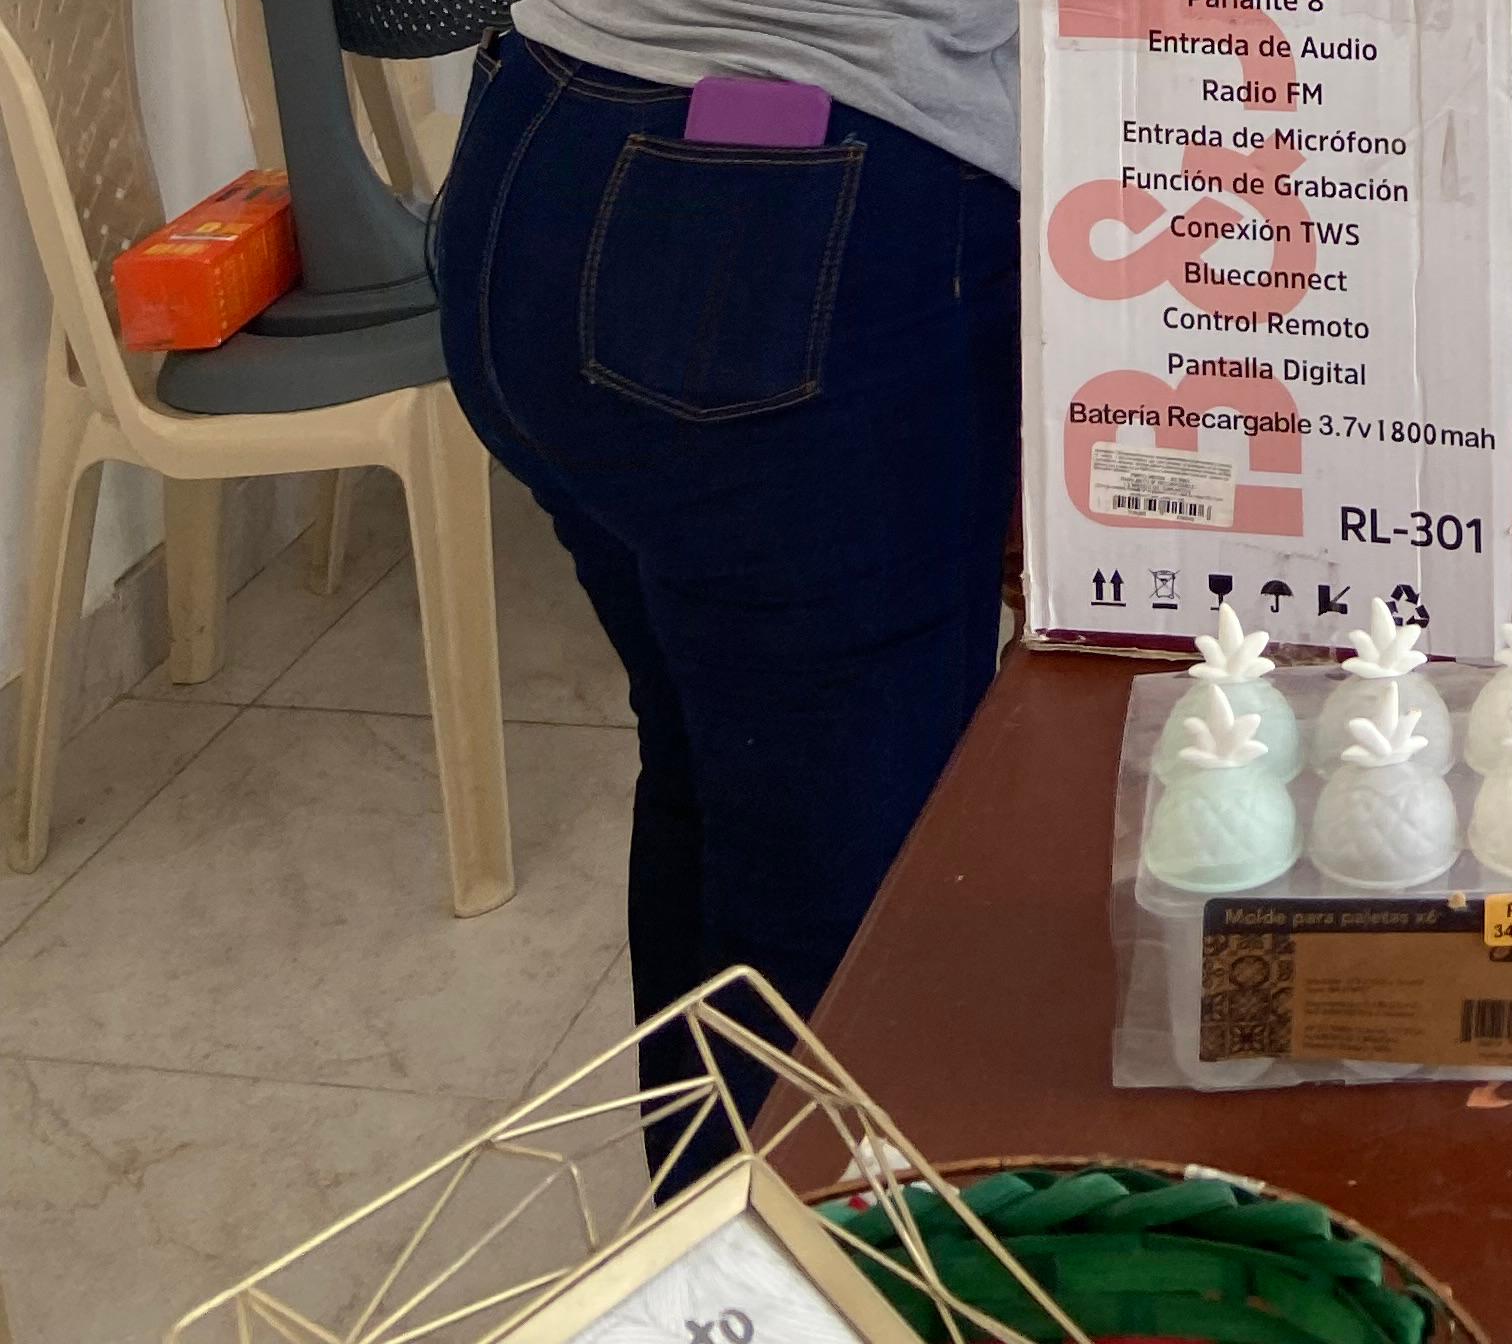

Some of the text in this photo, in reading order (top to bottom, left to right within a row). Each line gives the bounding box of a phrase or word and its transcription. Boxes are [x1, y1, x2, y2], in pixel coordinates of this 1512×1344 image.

[1149, 29, 1378, 61] Entrada de Audio
[1202, 79, 1323, 106] Radio FM
[1123, 120, 1407, 156] Entrada de Micrófono
[1122, 166, 1408, 202] Función de Grabación
[1170, 215, 1360, 246] Conexión TWS
[1184, 261, 1348, 292] Blueconnect
[1163, 306, 1370, 339] Control Remoto
[1168, 352, 1366, 386] Pantalla Digital
[1069, 402, 1161, 426] Batería
[1167, 405, 1312, 437] Recargable
[1340, 506, 1483, 554] RL-301
[1225, 909, 1286, 925] Molde
[1293, 911, 1335, 927] para
